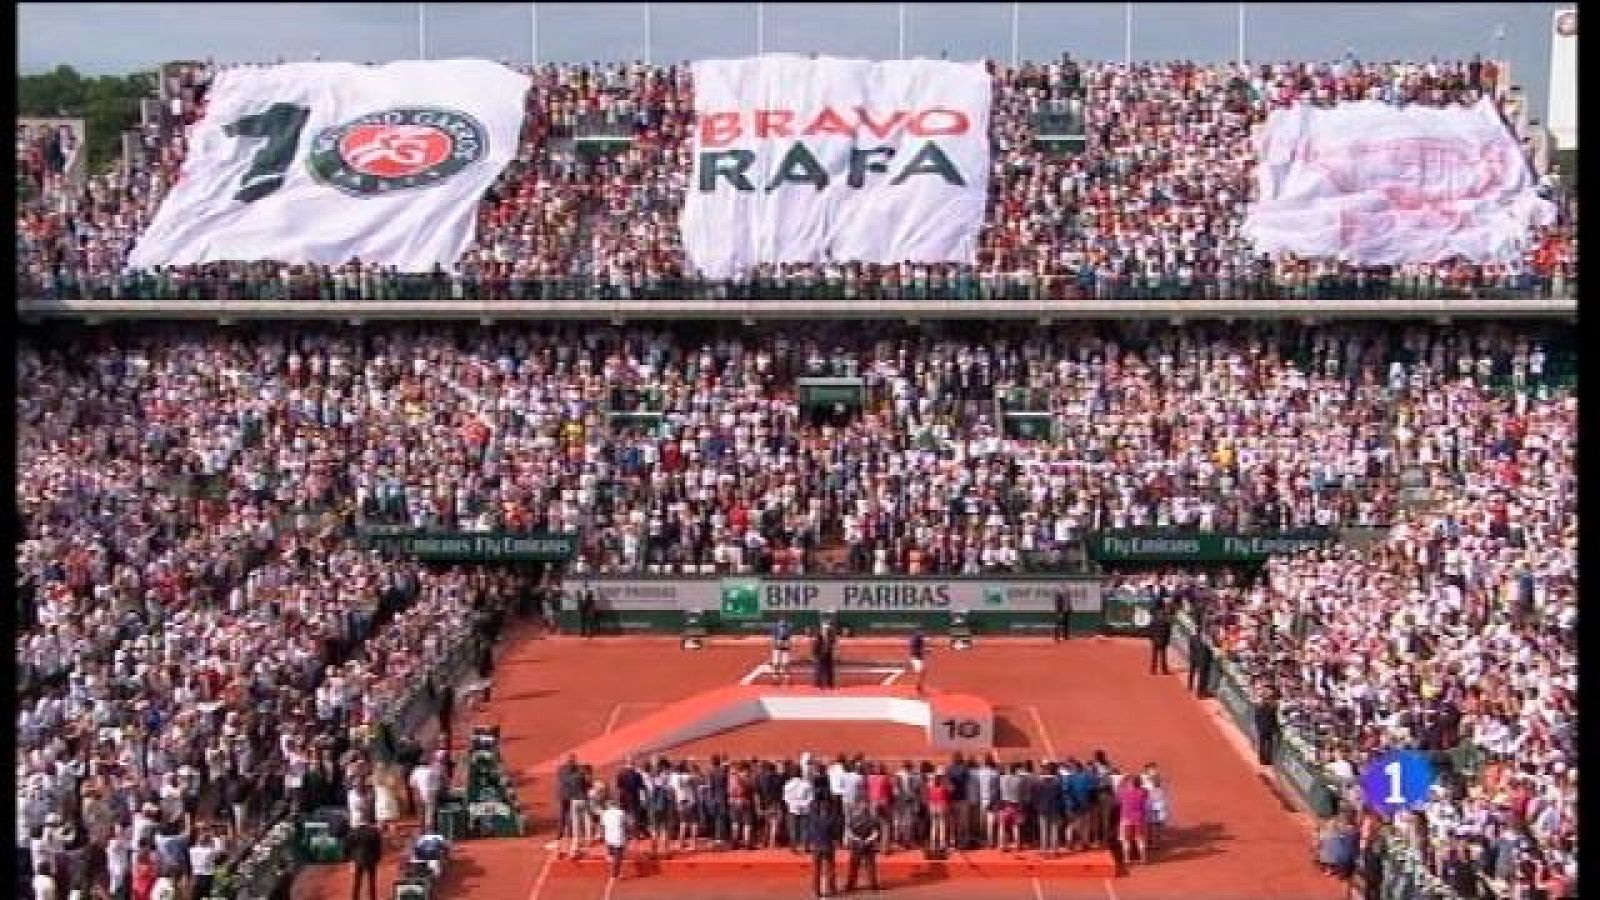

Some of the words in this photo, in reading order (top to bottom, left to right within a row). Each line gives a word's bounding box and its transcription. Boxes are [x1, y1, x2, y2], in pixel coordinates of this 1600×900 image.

[701, 106, 970, 147] BRAVO
[699, 140, 967, 194] RAFA
[1103, 537, 1129, 555] Fly
[1131, 537, 1200, 554] Emirates
[765, 584, 820, 607] BNP
[843, 584, 950, 607] PARIBAS
[942, 719, 981, 740] 10
